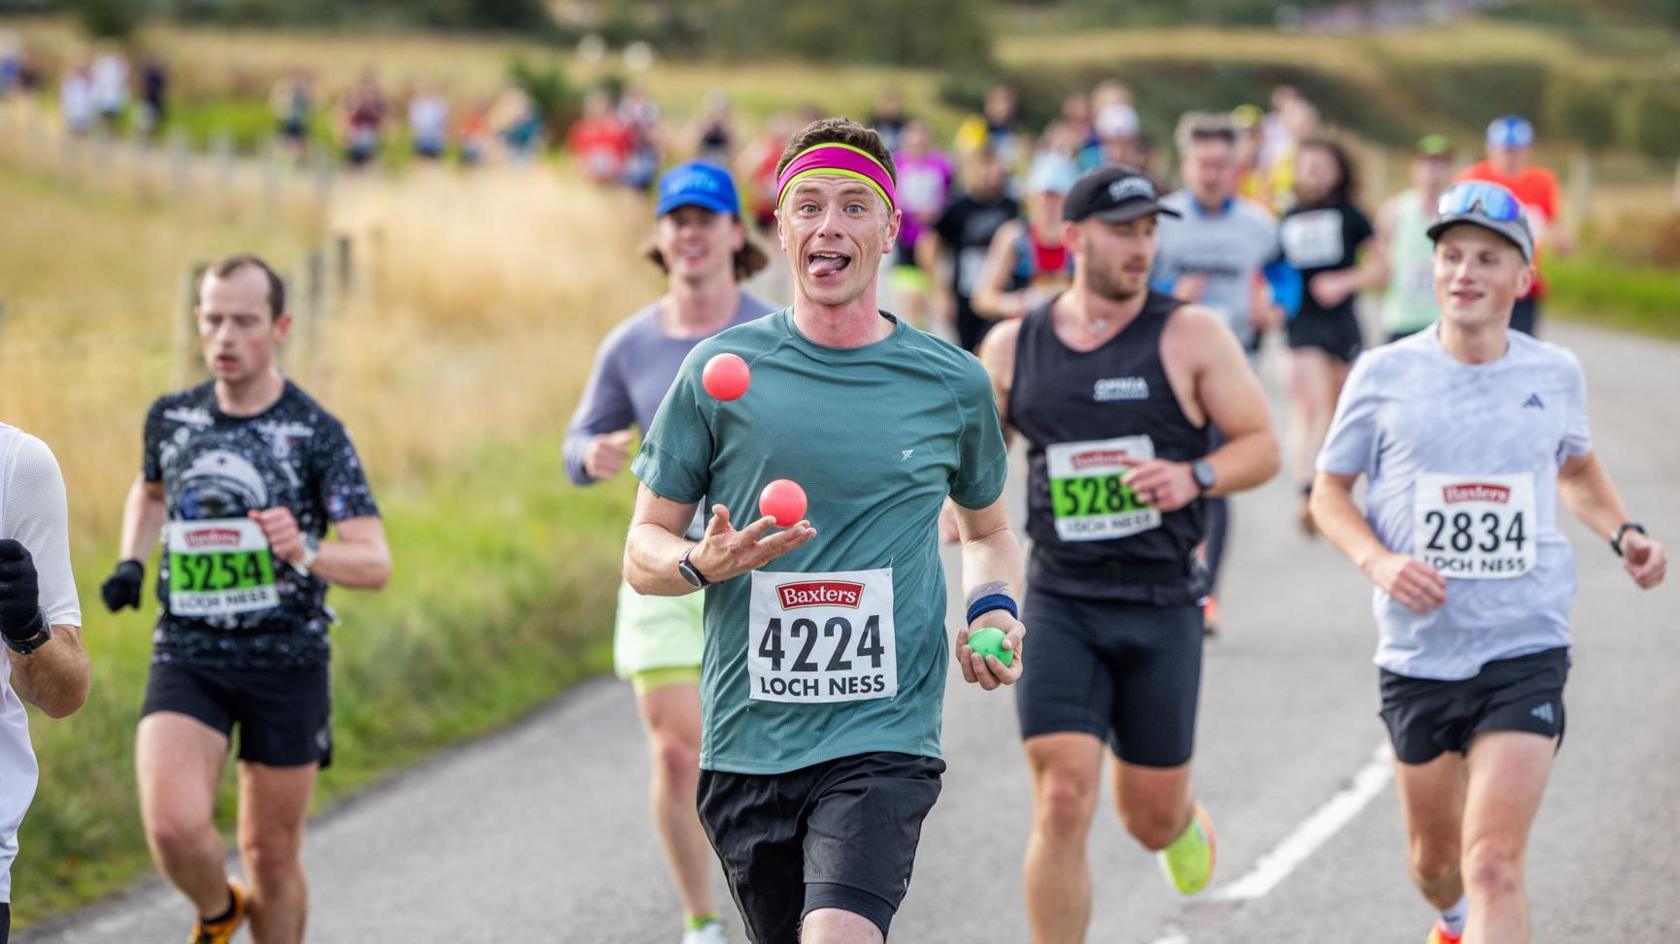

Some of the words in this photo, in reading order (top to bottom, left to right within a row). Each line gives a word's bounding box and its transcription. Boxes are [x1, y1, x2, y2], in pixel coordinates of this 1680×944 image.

[1425, 511, 1526, 553] 2834
[180, 552, 264, 592] 5254
[1481, 557, 1526, 573] NESS
[783, 585, 856, 605] Baxters
[758, 614, 885, 672] 4224
[760, 676, 819, 697] LOCH
[829, 674, 886, 695] NESS
